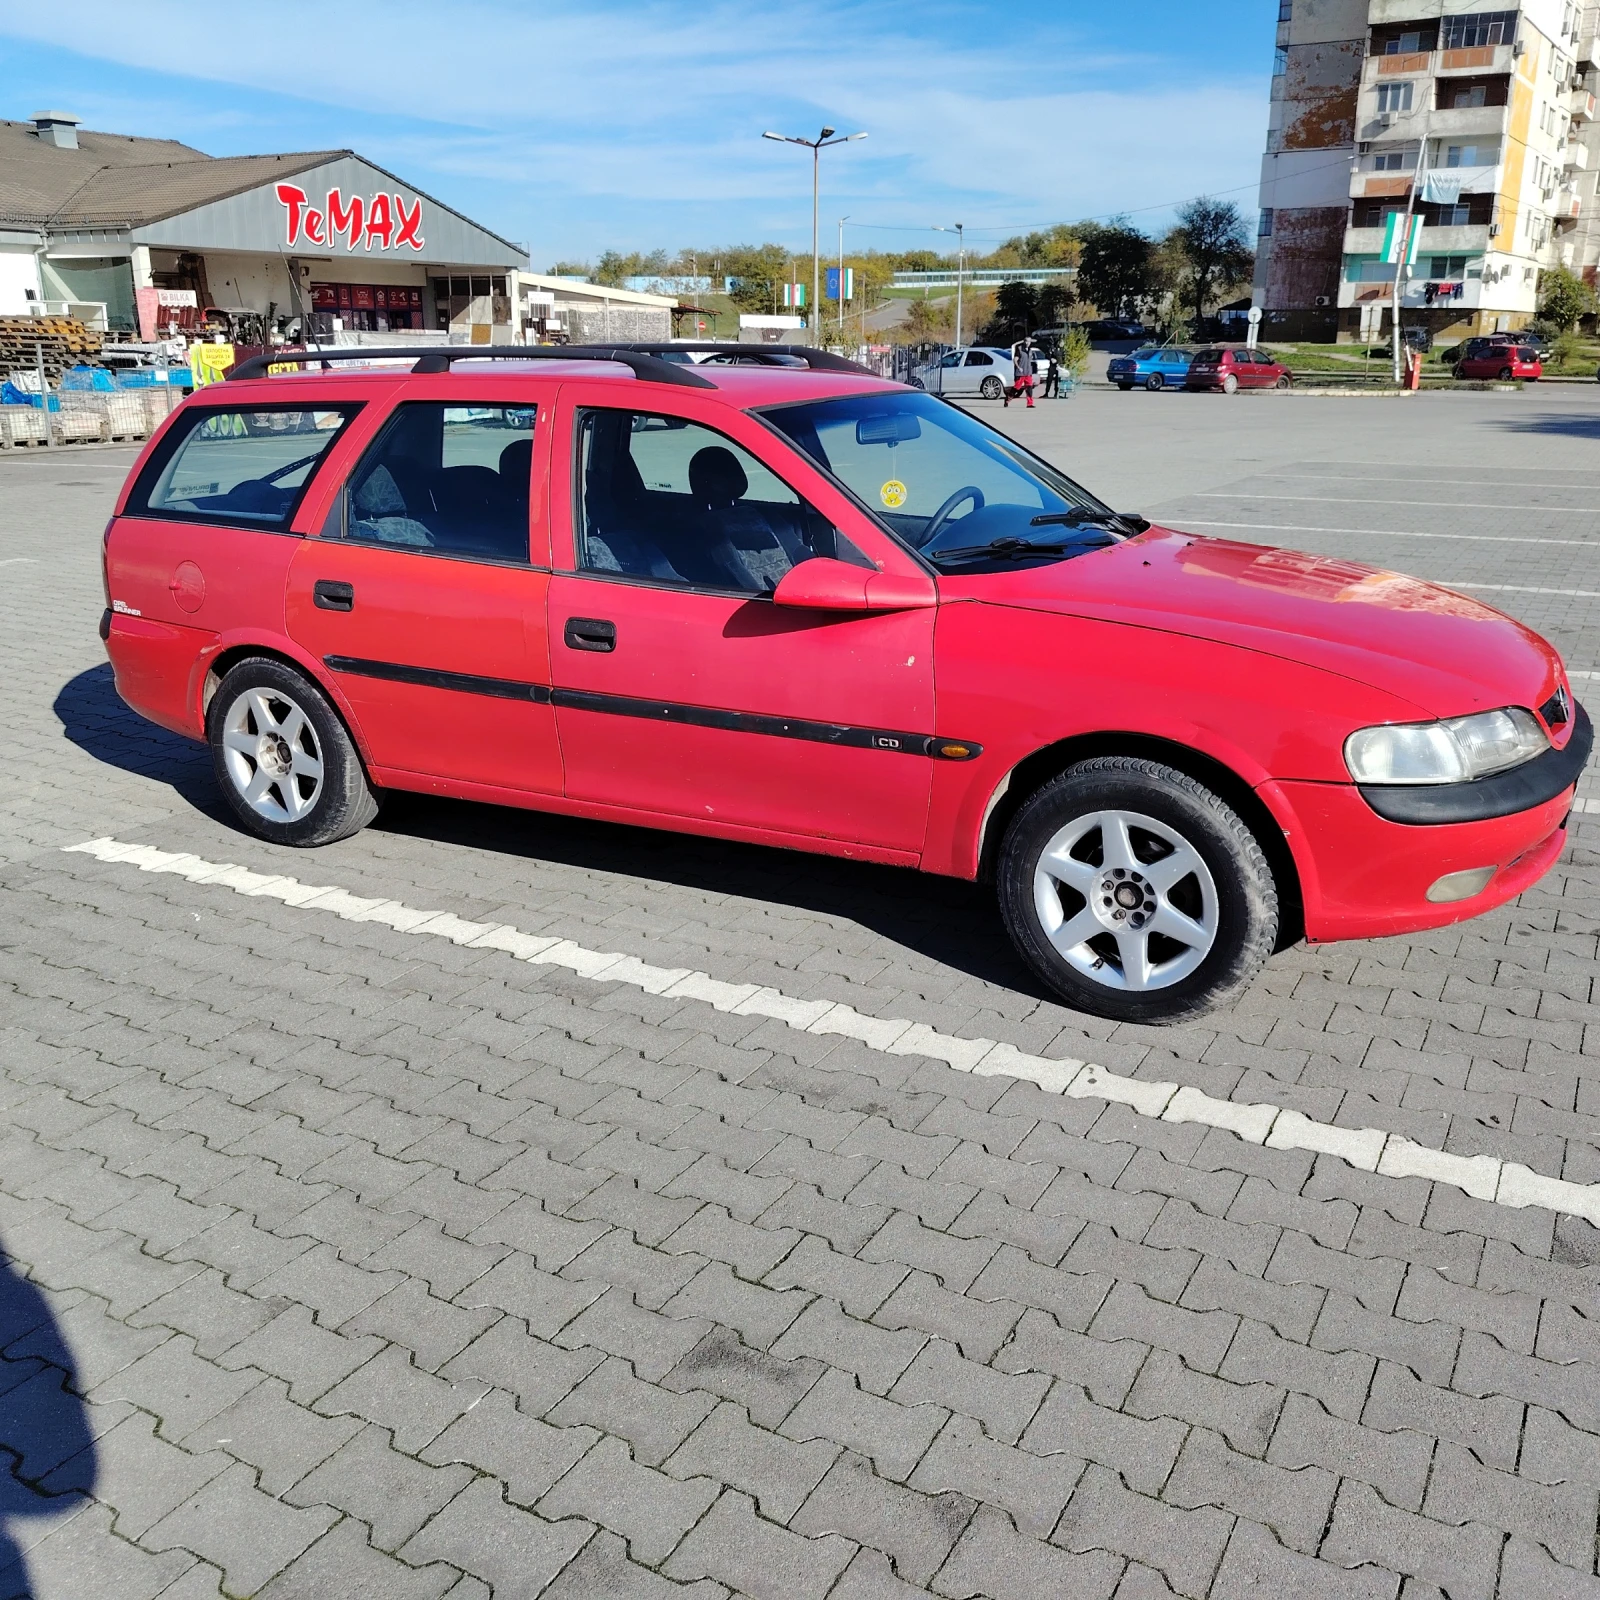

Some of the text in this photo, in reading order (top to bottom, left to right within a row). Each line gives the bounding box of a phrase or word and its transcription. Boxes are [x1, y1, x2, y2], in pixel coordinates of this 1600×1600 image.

[275, 183, 425, 251] TeMAX
[169, 293, 190, 302] BILKA
[878, 737, 899, 748] CD
